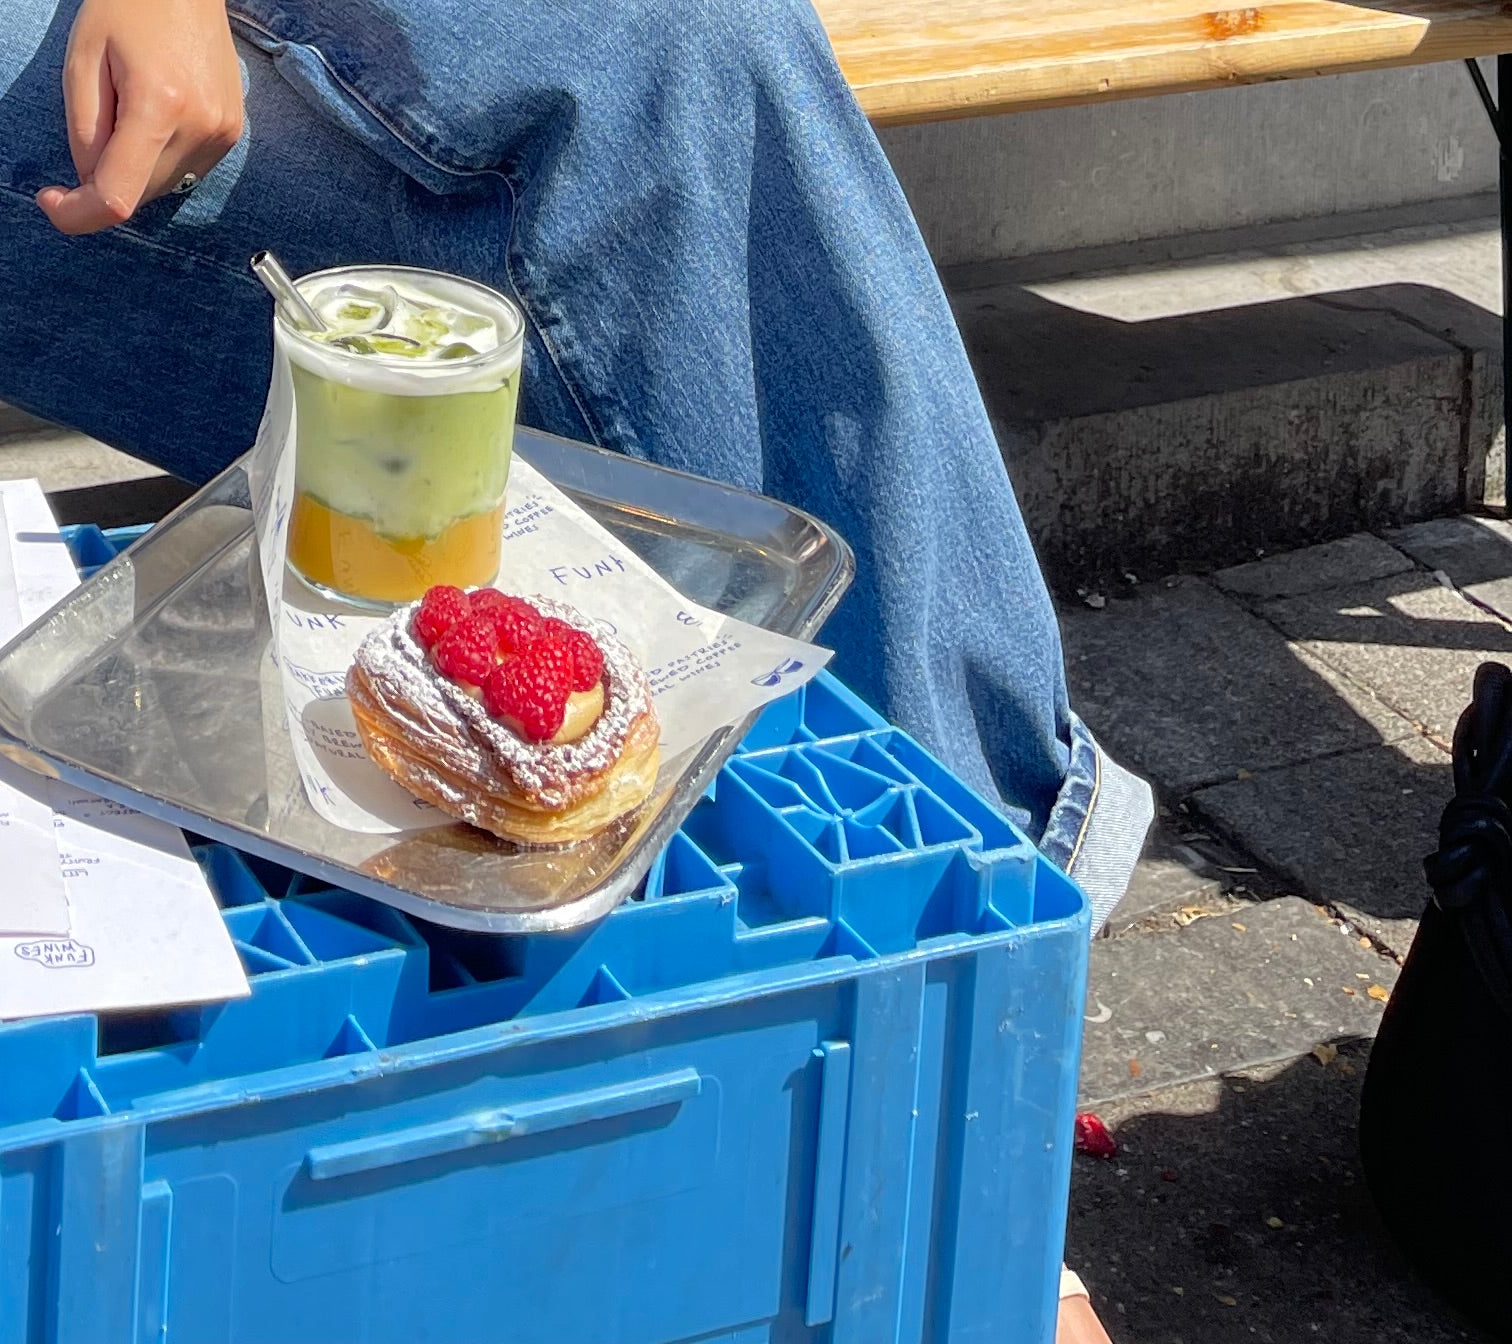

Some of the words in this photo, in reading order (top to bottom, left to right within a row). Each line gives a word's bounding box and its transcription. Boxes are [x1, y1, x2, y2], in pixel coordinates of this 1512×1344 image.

[287, 611, 345, 630] UNK
[21, 941, 76, 957] WINES
[43, 949, 87, 964] FUNK
